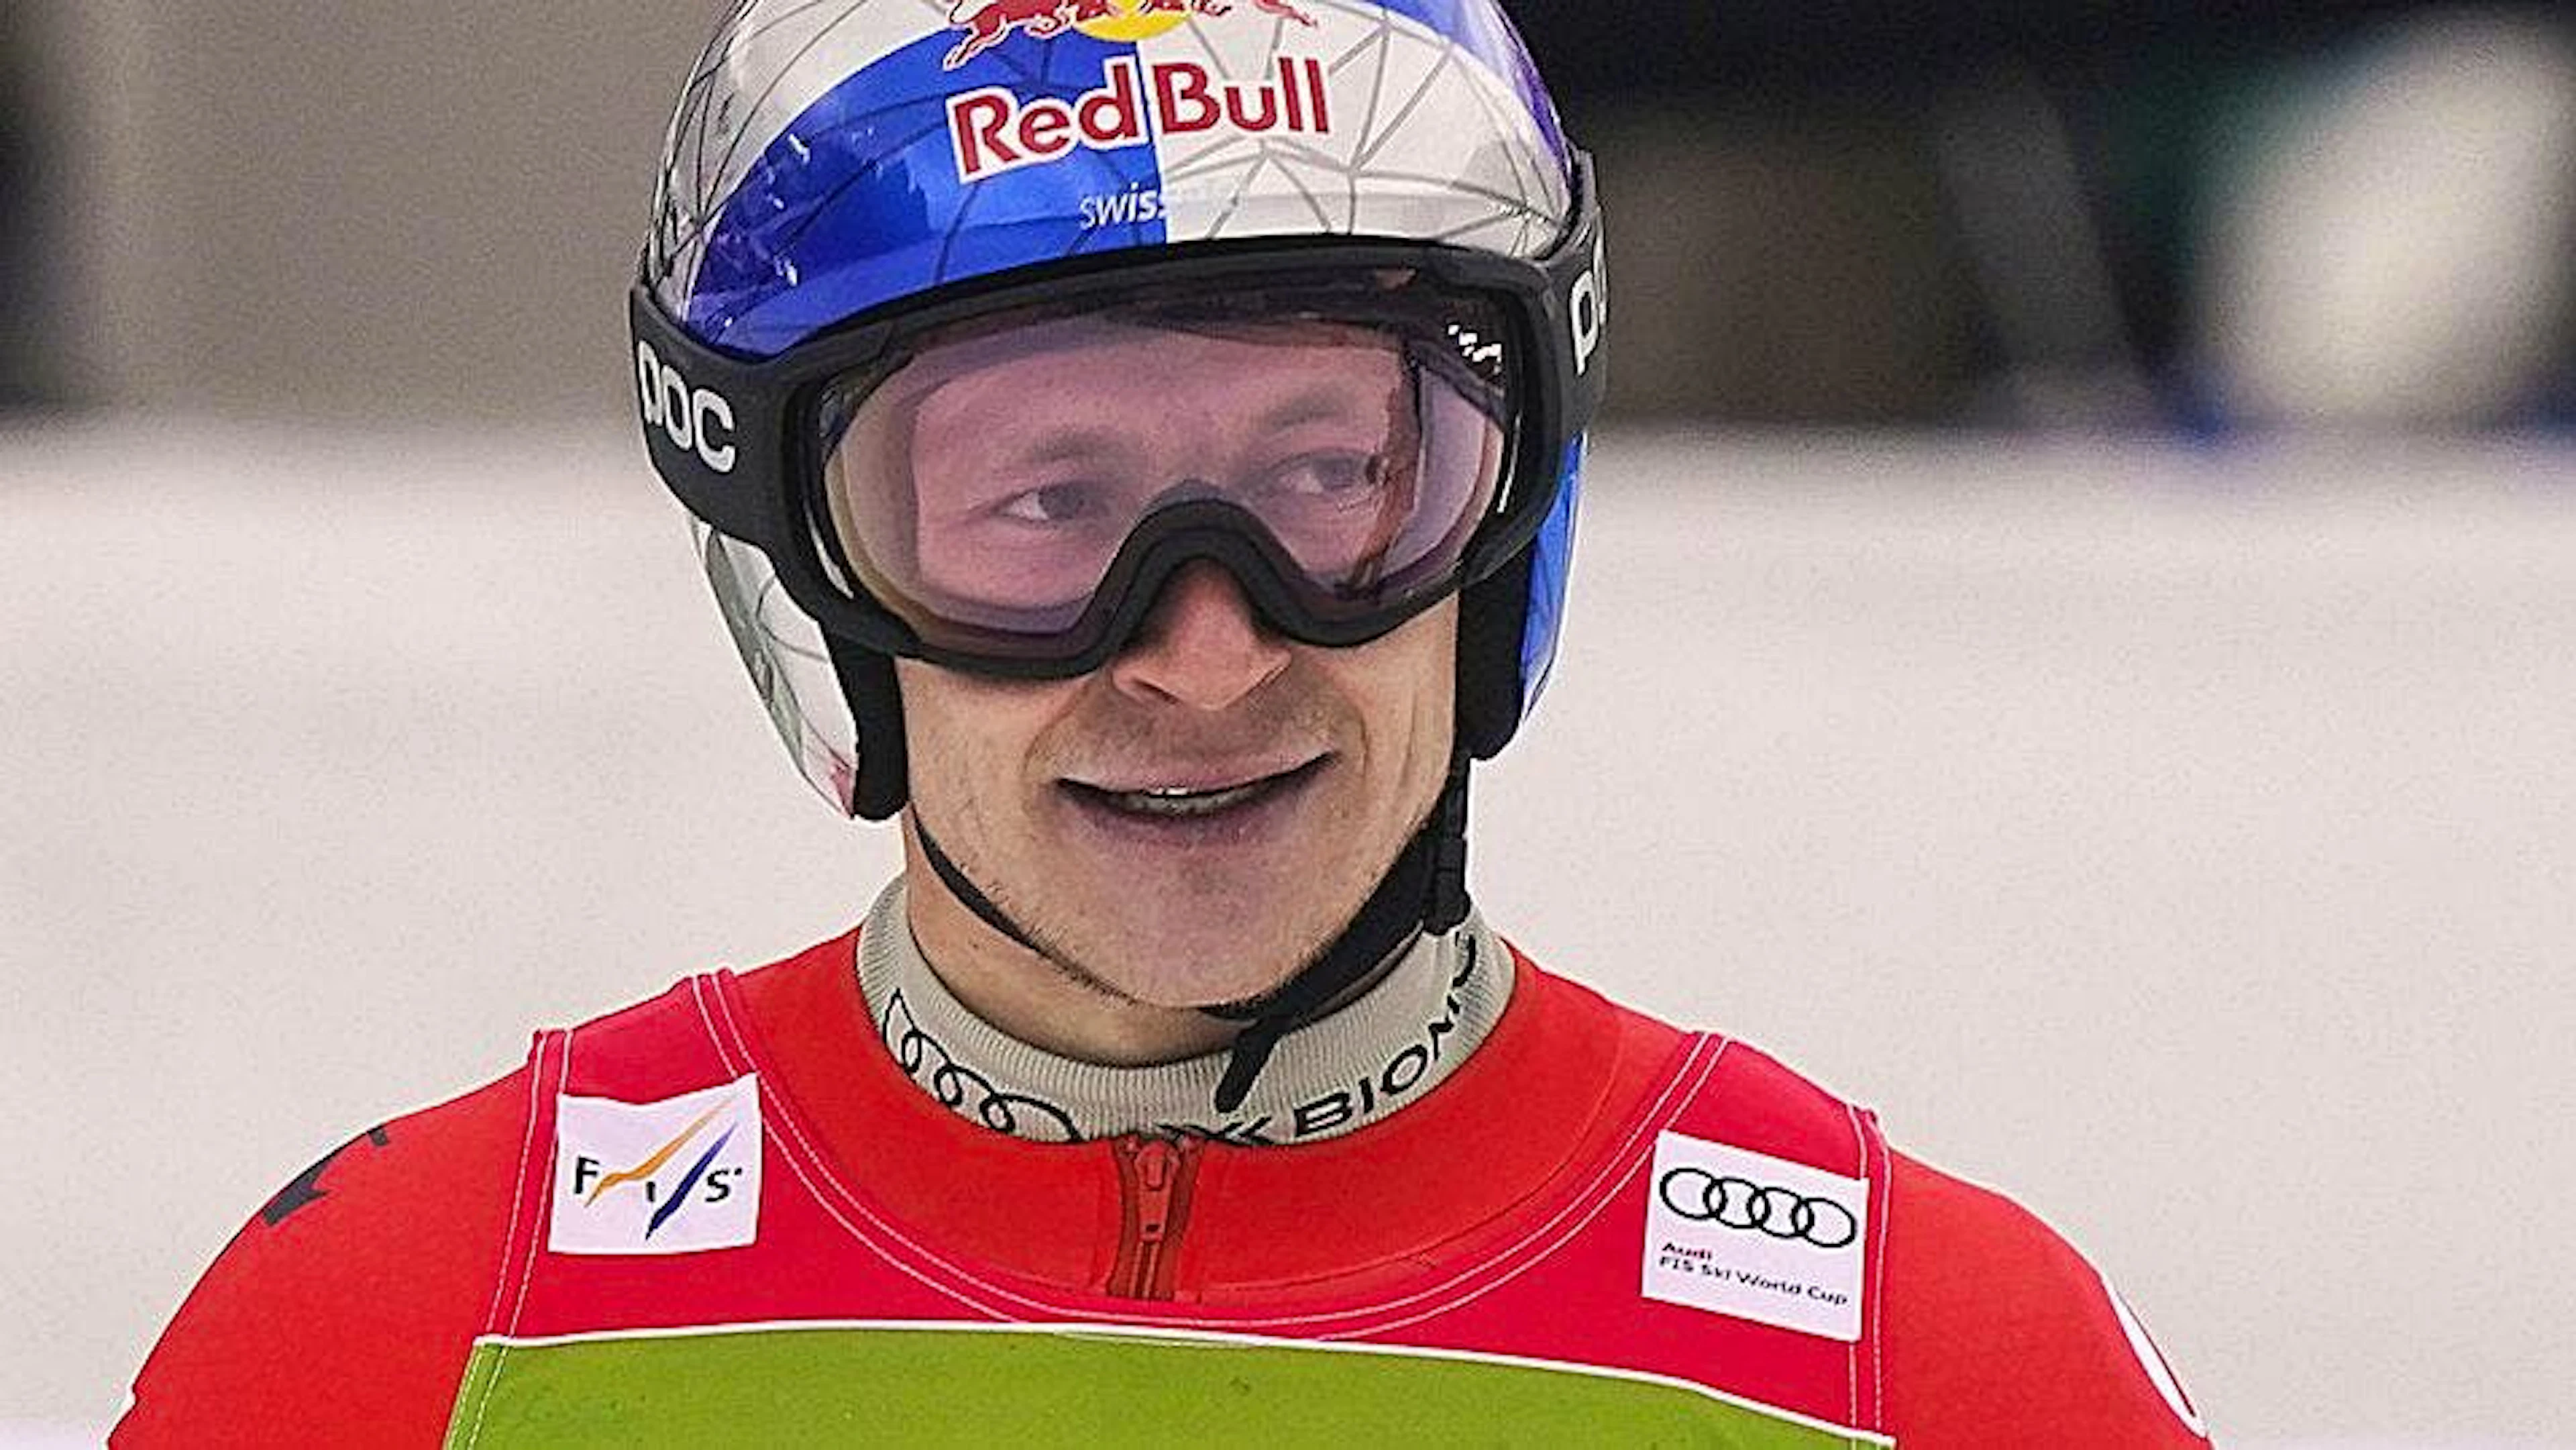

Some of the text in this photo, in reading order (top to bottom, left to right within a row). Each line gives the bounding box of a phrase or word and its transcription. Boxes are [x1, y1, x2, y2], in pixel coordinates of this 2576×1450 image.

[950, 56, 1330, 178] Red Bull
[1662, 1243, 1712, 1259] Audi
[1660, 1256, 1847, 1305] FIS Ski World Cup
